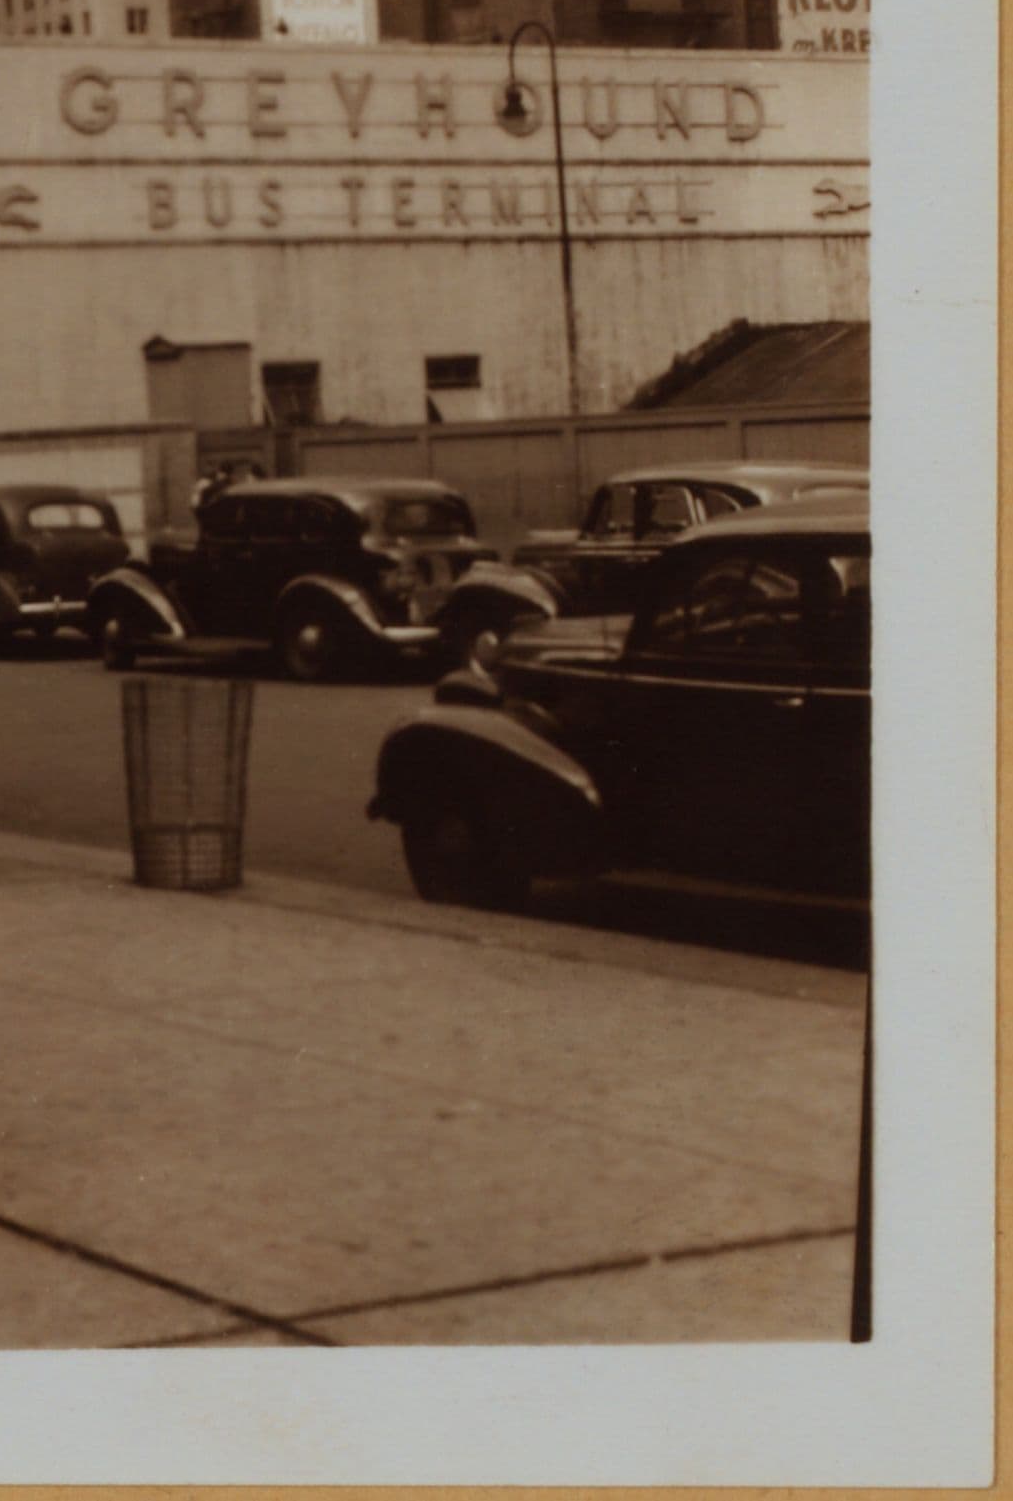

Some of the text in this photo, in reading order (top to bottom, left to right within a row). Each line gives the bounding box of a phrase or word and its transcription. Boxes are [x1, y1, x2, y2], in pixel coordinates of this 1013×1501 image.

[59, 65, 766, 143] GREYHOUND
[146, 175, 700, 231] BUS TERMINAL
